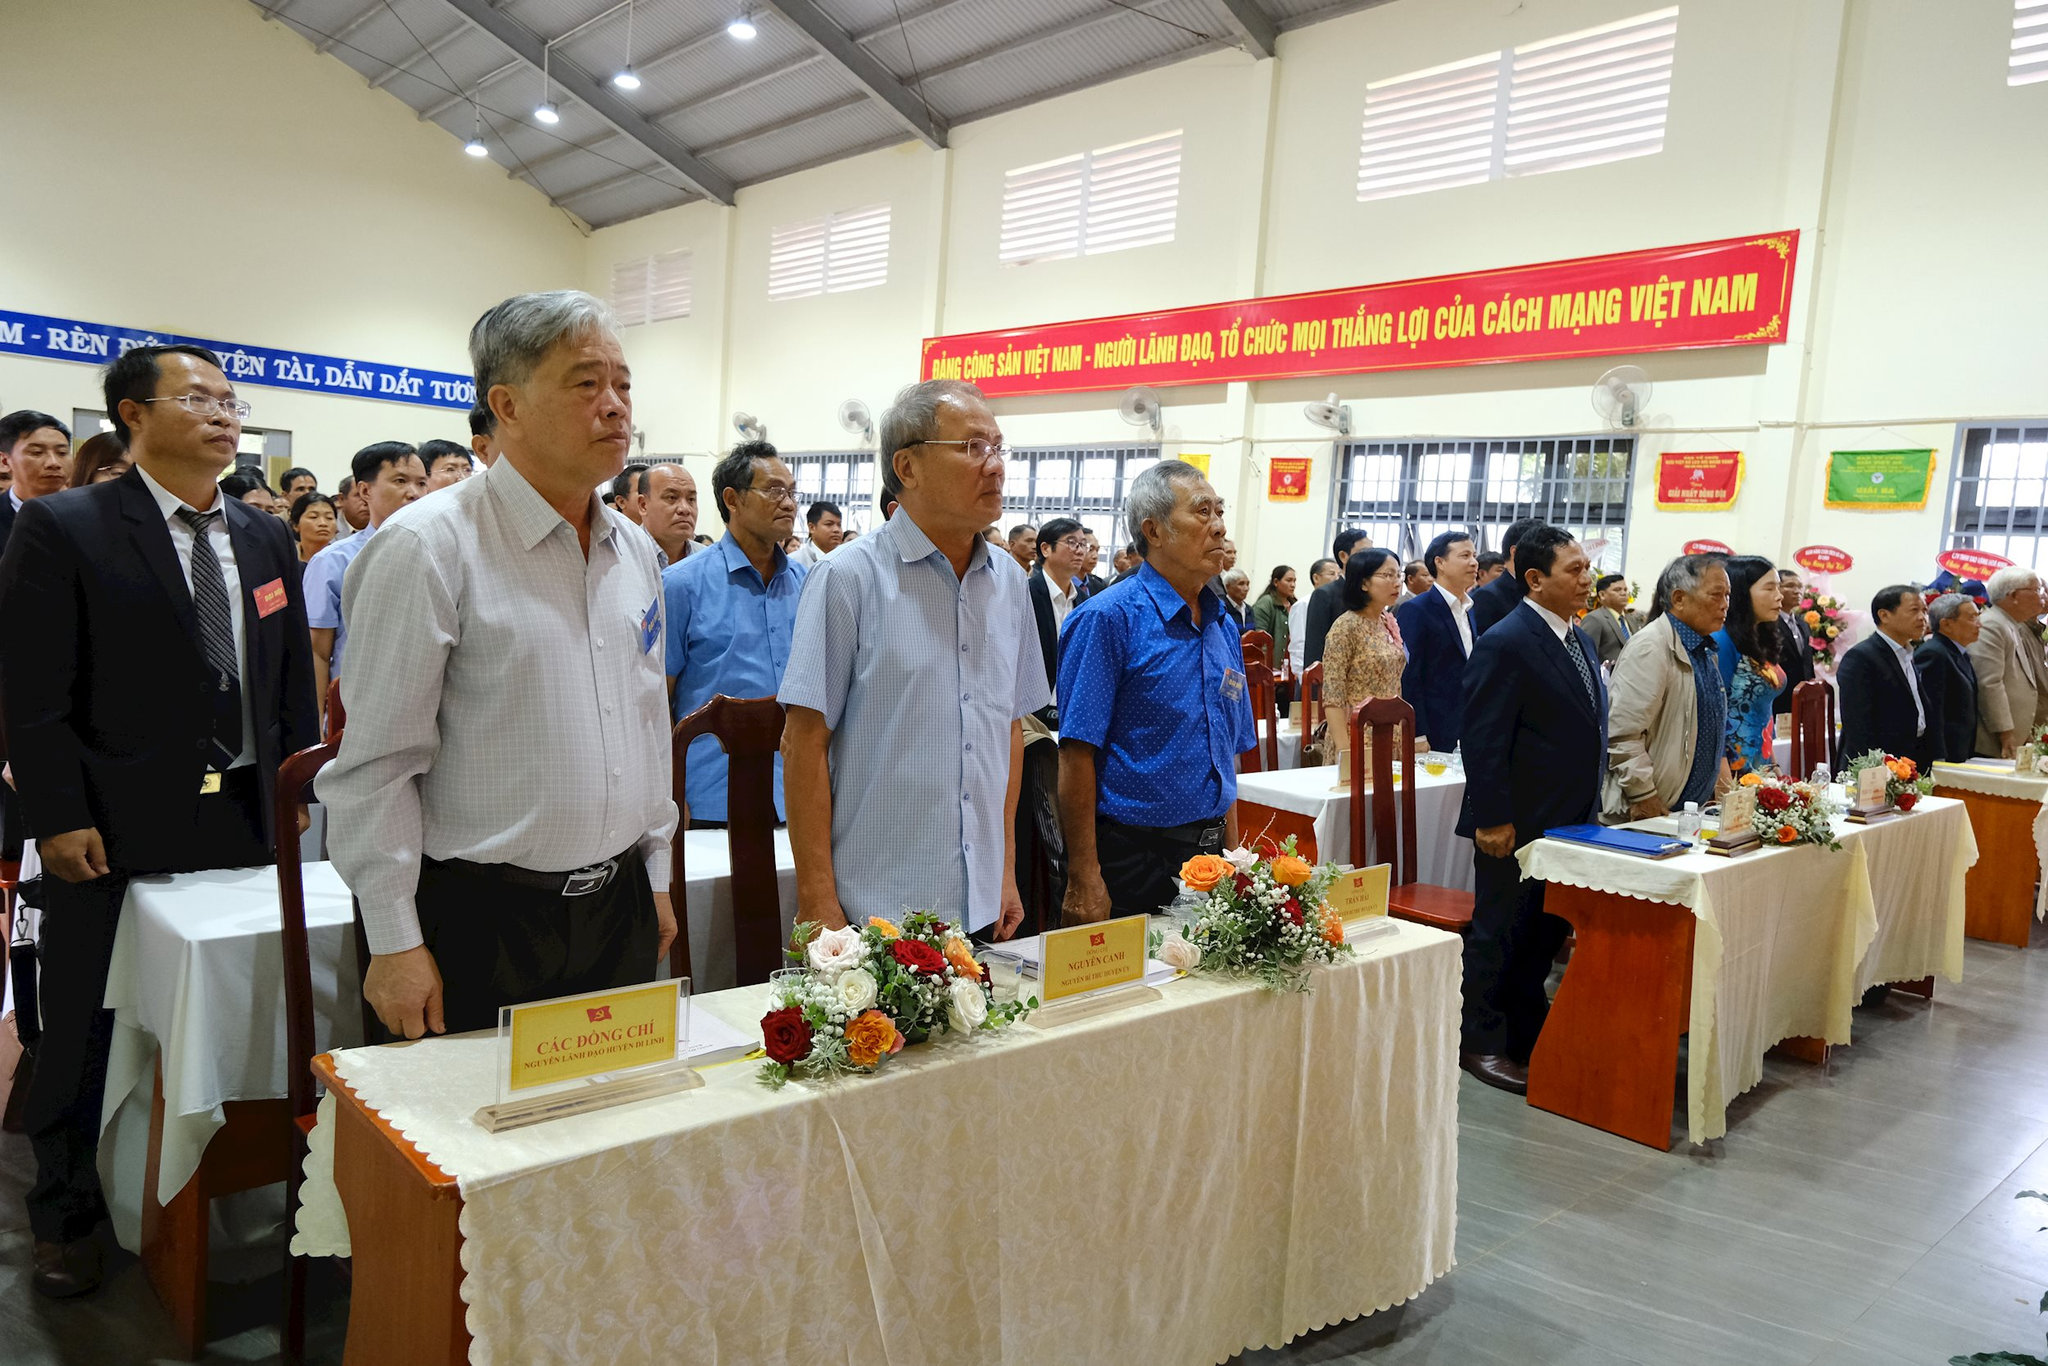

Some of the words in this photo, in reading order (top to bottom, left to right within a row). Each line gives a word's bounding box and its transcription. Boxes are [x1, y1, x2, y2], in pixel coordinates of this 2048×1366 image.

[932, 351, 962, 380] ĐẢNG
[963, 350, 995, 384] CỘNG
[996, 344, 1022, 377] SẢN
[1024, 343, 1050, 379] VIỆT
[1052, 345, 1083, 372] NAM
[1093, 333, 1136, 369] NGƯỜI
[1139, 332, 1178, 365] LÃNH
[1181, 331, 1215, 367] ĐẠO,
[1220, 317, 1242, 358] TỔ
[1243, 318, 1288, 356] CHỨC
[1292, 319, 1327, 357] MỌI
[1332, 304, 1393, 349] THẮNG
[1397, 306, 1429, 349] LỢI
[1434, 294, 1476, 339] CỦA
[1482, 292, 1544, 336] CÁCH
[1548, 288, 1623, 335] MẠNG
[1630, 275, 1685, 328] VIỆT
[1690, 272, 1759, 317] NAM
[47, 325, 110, 356] RÈN
[211, 348, 266, 378] YỆN
[273, 355, 320, 386] TÀI,
[325, 361, 374, 390] DẪN
[379, 368, 424, 396] DẮT
[537, 1036, 573, 1055] CÁC
[577, 1028, 622, 1048] ĐỒNG
[626, 1019, 655, 1038] CHÍ
[587, 1048, 605, 1058] ĐẠO
[606, 1043, 634, 1054] HUYỆN
[635, 1041, 644, 1049] DI
[645, 1036, 665, 1046] LINH
